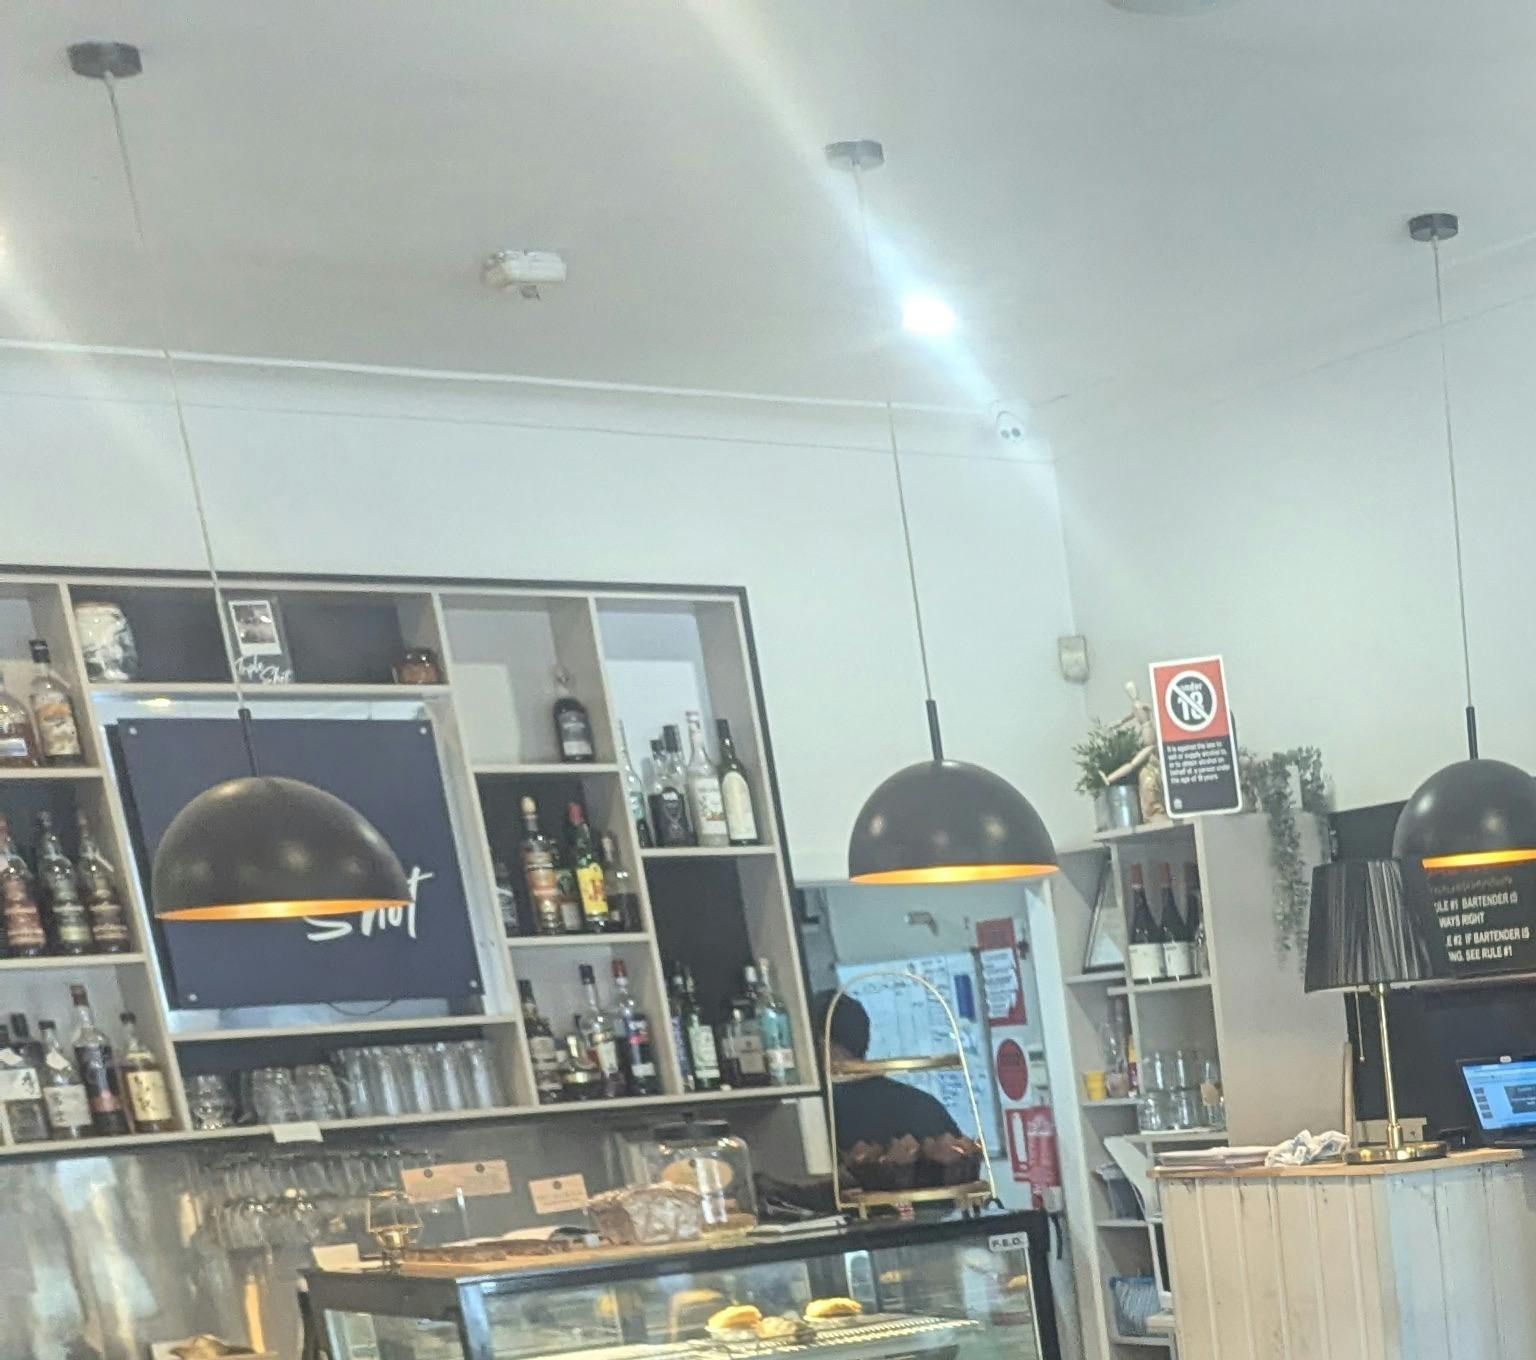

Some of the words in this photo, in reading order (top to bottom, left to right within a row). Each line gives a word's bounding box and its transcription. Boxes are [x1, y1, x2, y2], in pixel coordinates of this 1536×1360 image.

[1177, 691, 1205, 720] 18
[1462, 891, 1509, 910] BARTENDER
[1439, 914, 1460, 928] WAYS
[1462, 911, 1485, 927] RIGHT
[1473, 927, 1520, 944] BARTENDER
[1466, 947, 1481, 961] SEE
[1481, 945, 1502, 960] RULE
